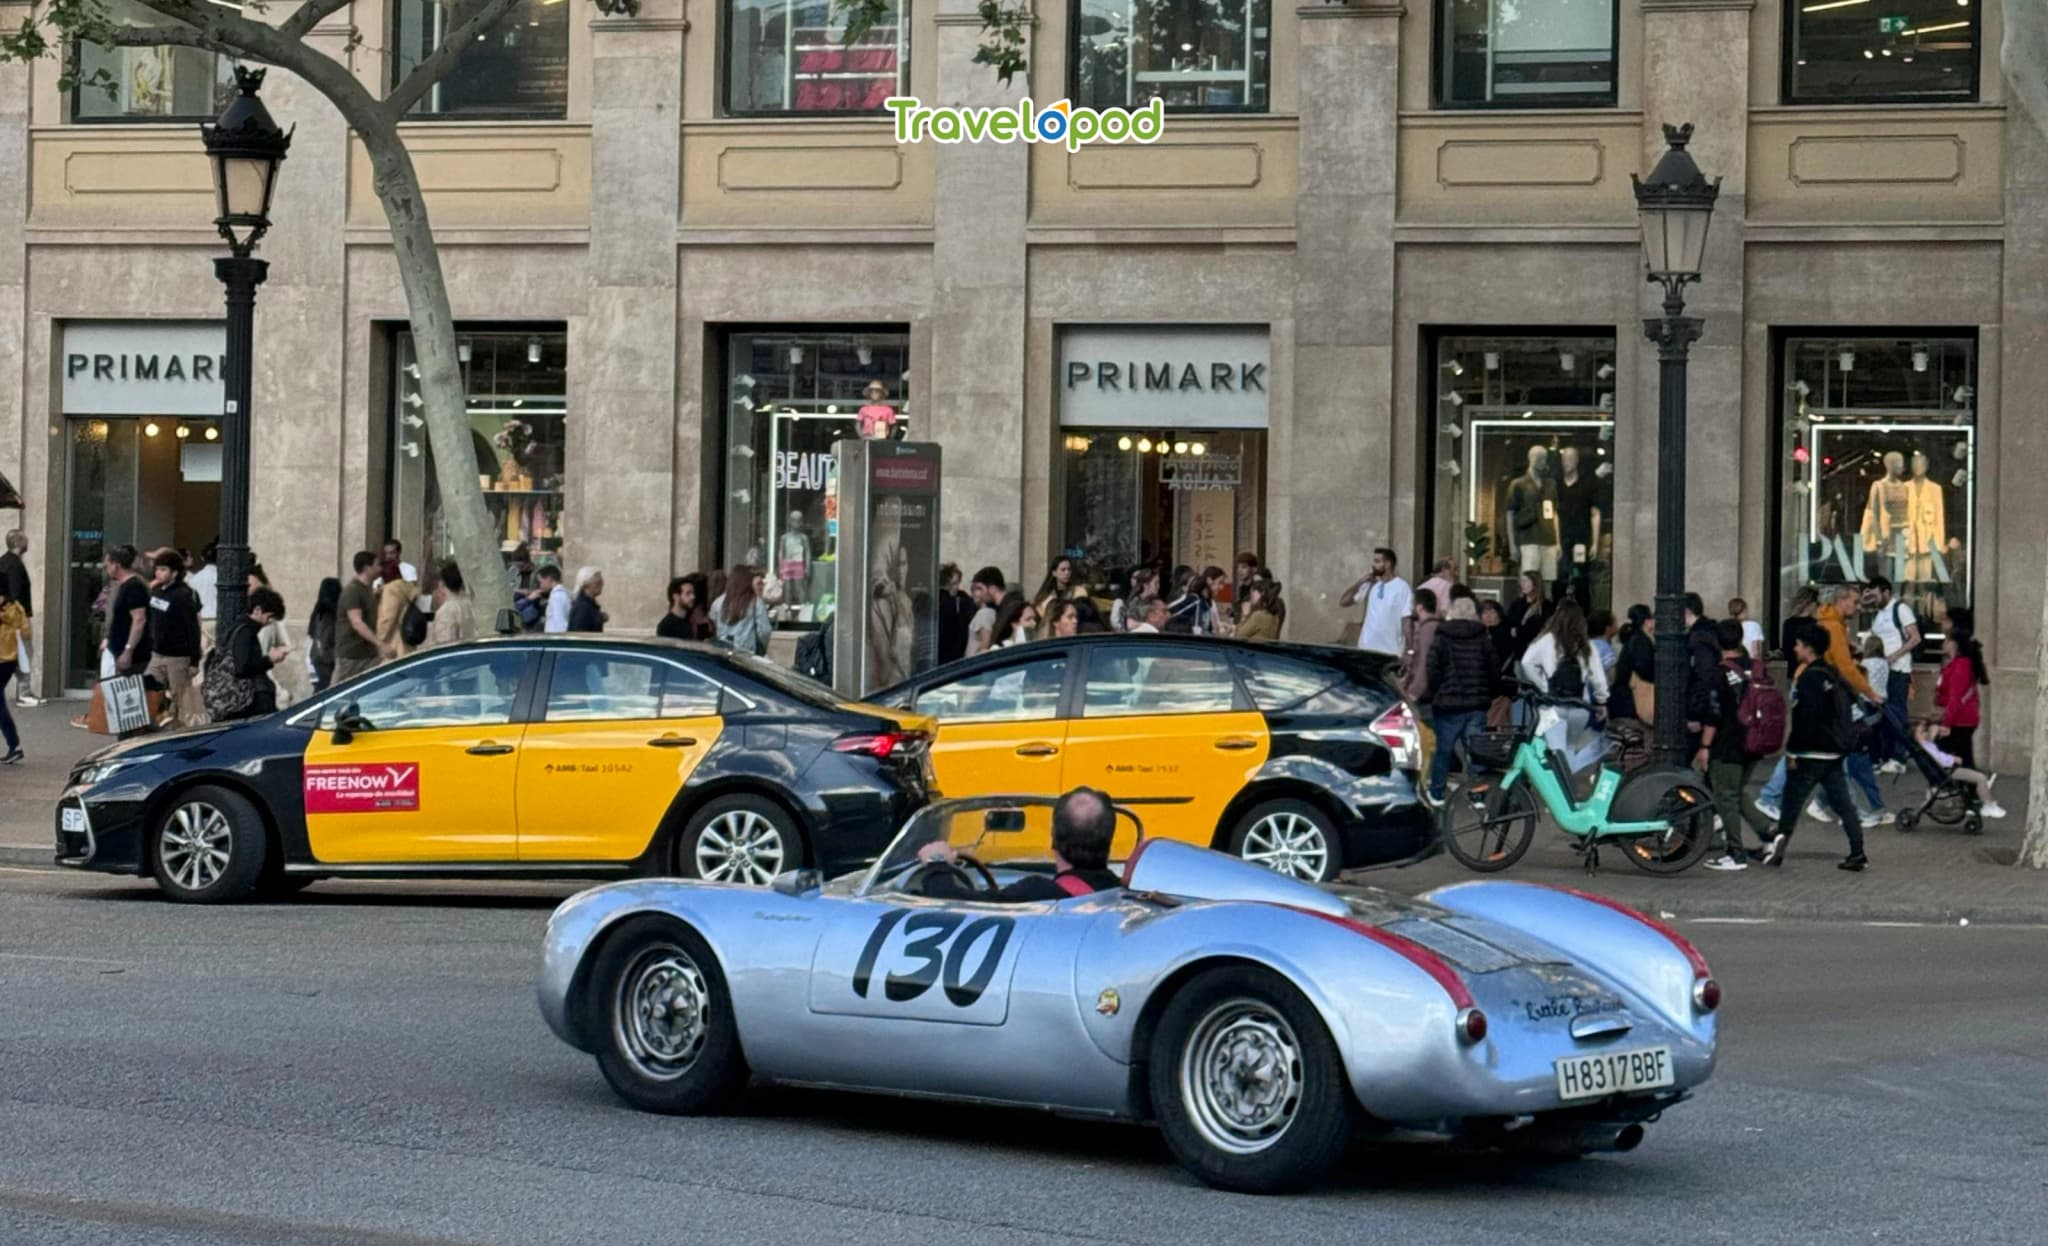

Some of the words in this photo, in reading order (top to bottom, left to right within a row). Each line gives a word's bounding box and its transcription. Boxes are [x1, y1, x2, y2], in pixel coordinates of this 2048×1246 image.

[1067, 361, 1265, 391] PRIMARK
[306, 775, 388, 791] FREENOW
[852, 908, 1016, 1008] 130
[1563, 1050, 1665, 1094] H8317BBF
